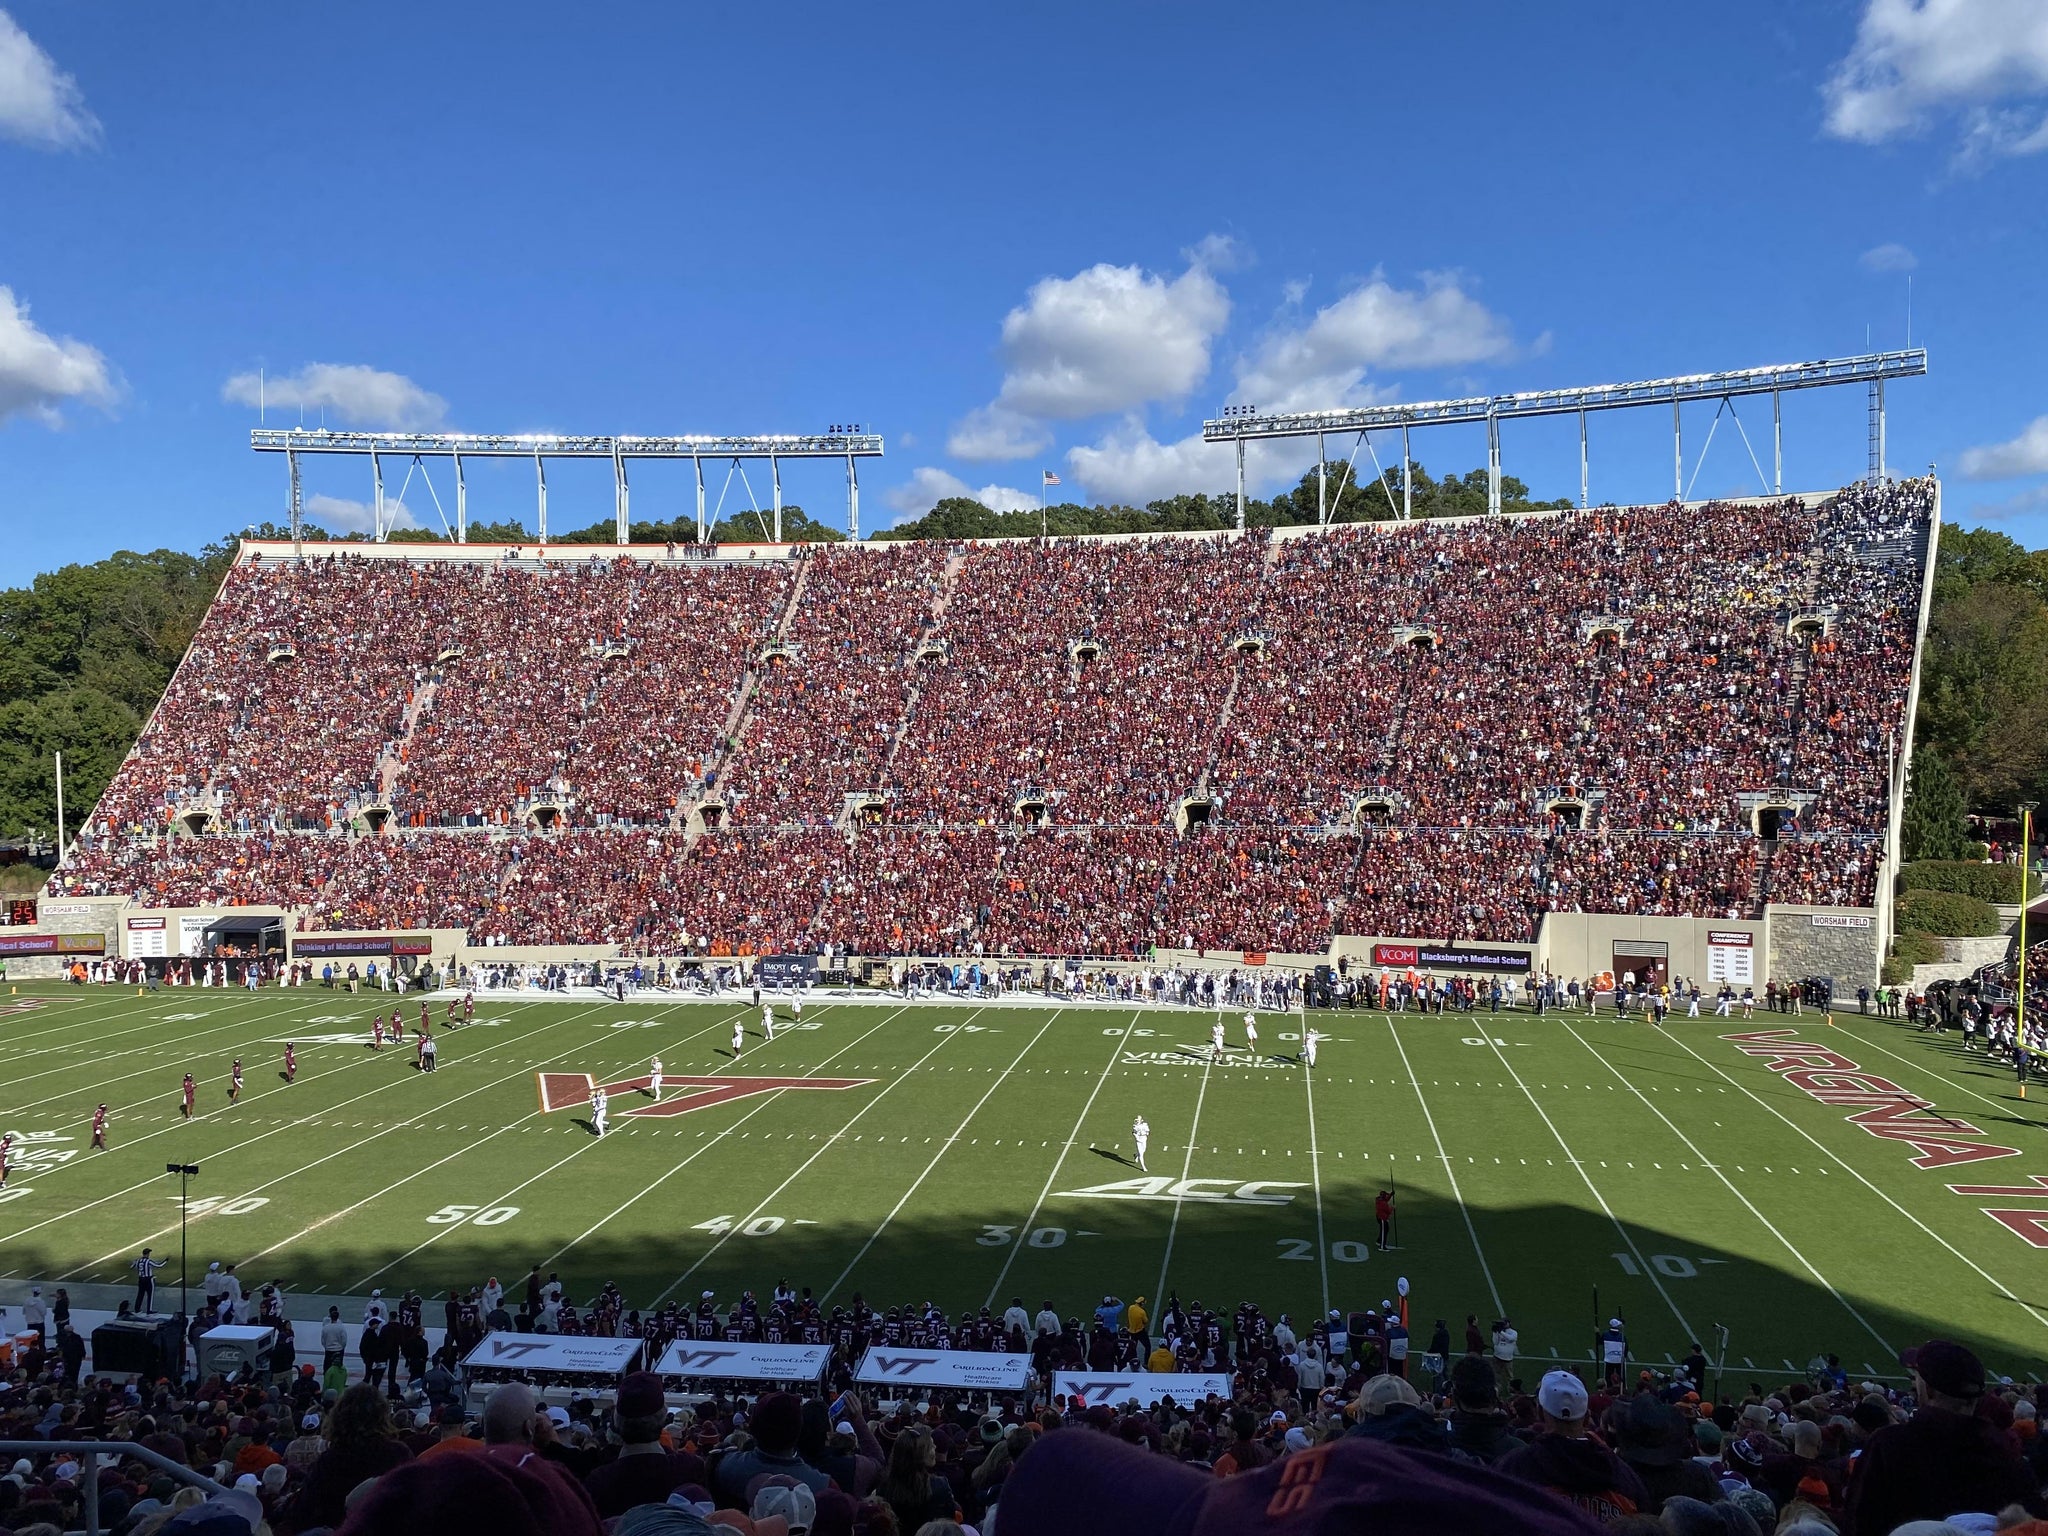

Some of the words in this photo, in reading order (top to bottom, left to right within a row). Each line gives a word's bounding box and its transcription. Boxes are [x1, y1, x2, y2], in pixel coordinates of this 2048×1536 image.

[14, 907, 33, 920] 25
[45, 906, 72, 914] WORSHAM
[74, 905, 89, 913] FIELD
[1813, 916, 1848, 926] WORSHAM
[1849, 917, 1868, 927] FIELD
[19, 940, 53, 949] School?
[64, 937, 100, 948] VCOM
[296, 944, 326, 952] Thinking
[364, 941, 391, 949] School?
[396, 941, 429, 950] VCOM
[1380, 946, 1414, 961] VCOM
[1421, 952, 1468, 964] Blacksburg's
[1470, 954, 1500, 964] Medical
[1216, 1060, 1297, 1069] Union
[1717, 1029, 2024, 1170] VIRGINIA
[1050, 1176, 1312, 1206] ACC
[174, 1195, 271, 1215] 40
[425, 1205, 521, 1226] 50
[690, 1215, 787, 1236] 40
[975, 1224, 1067, 1248] 30
[1276, 1238, 1370, 1262] 20
[1610, 1253, 1700, 1278] 10
[643, 1324, 660, 1338] 27
[698, 1324, 713, 1336] 20
[884, 1328, 900, 1340] 55
[767, 1332, 782, 1344] 90
[214, 1351, 241, 1360] ACC
[491, 1340, 553, 1360] VT
[562, 1348, 598, 1356] CARILION
[675, 1348, 741, 1369] VT
[751, 1356, 788, 1364] CARILION
[873, 1355, 941, 1375] VT
[952, 1363, 990, 1371] CARILION
[1063, 1381, 1135, 1401] VT
